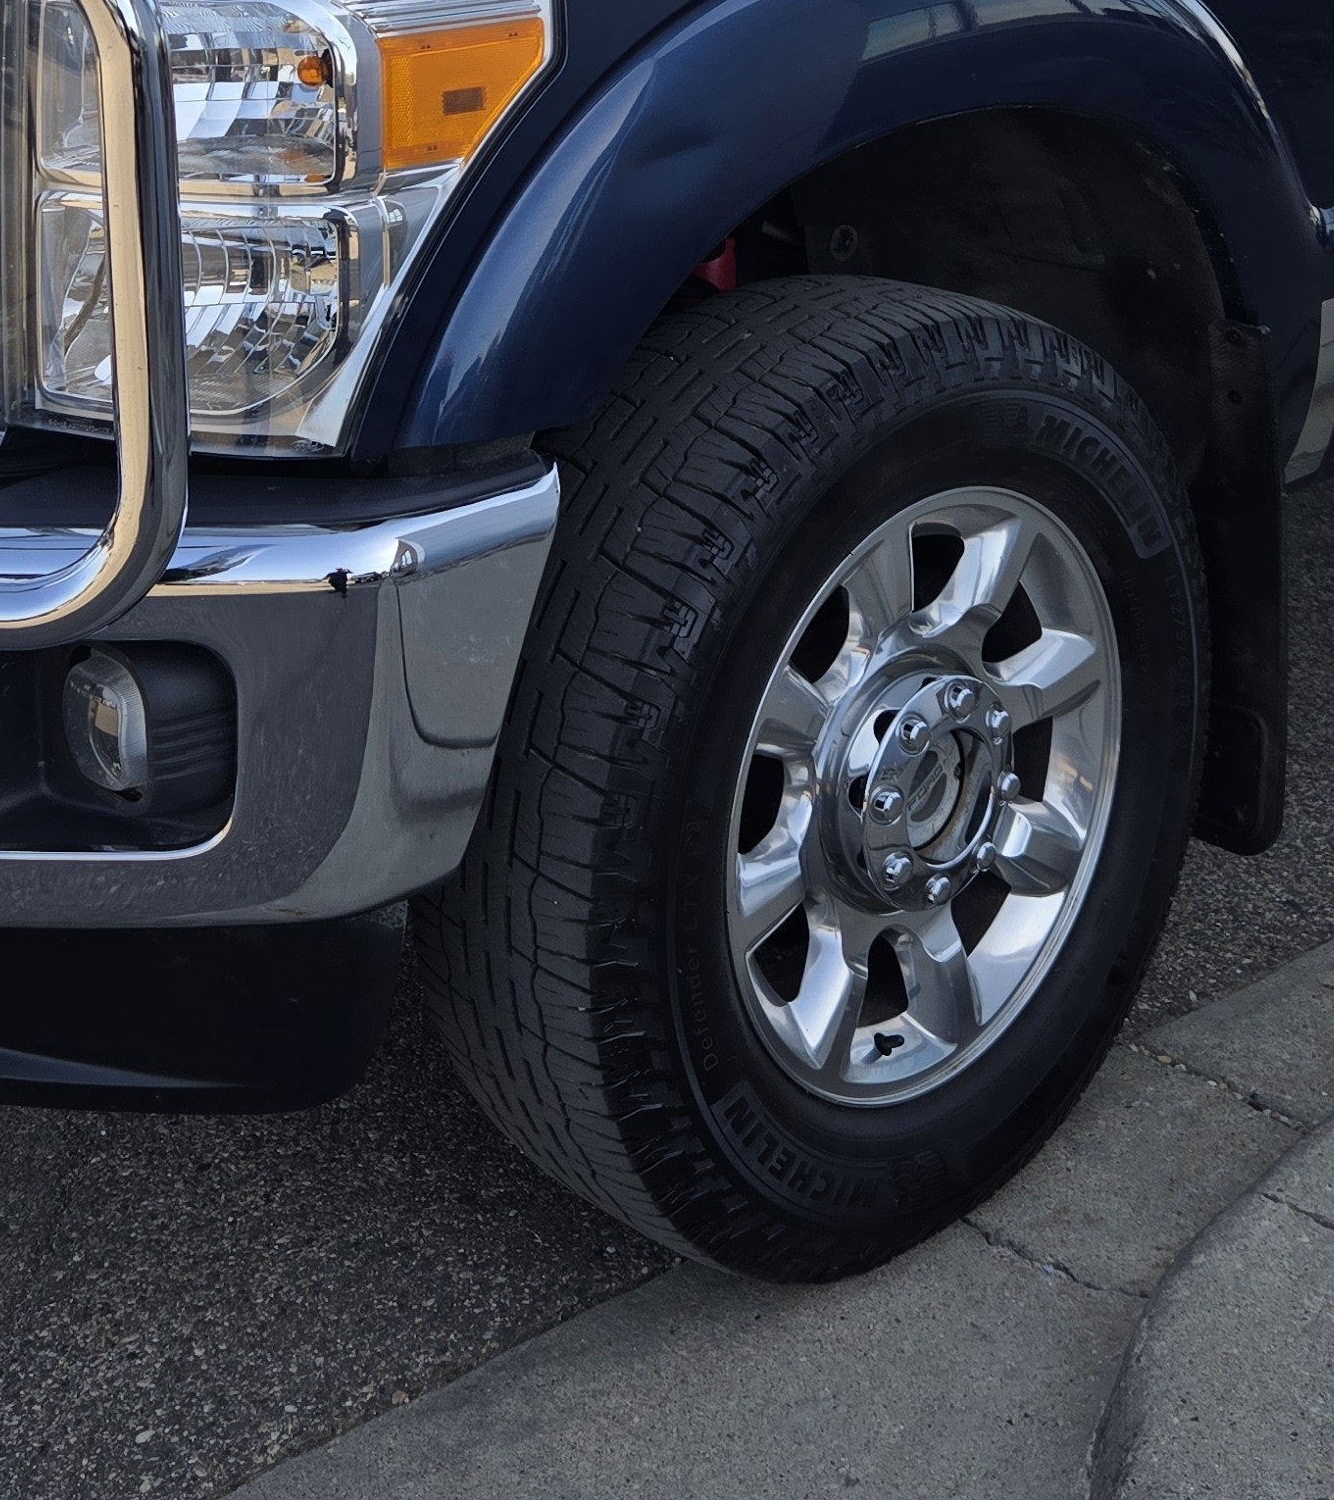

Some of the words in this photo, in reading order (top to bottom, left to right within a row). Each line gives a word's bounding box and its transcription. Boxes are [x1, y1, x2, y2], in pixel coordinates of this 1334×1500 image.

[1035, 414, 1165, 548] MICHELIN
[686, 947, 720, 1072] Defender
[723, 1094, 887, 1207] MICHELIN
